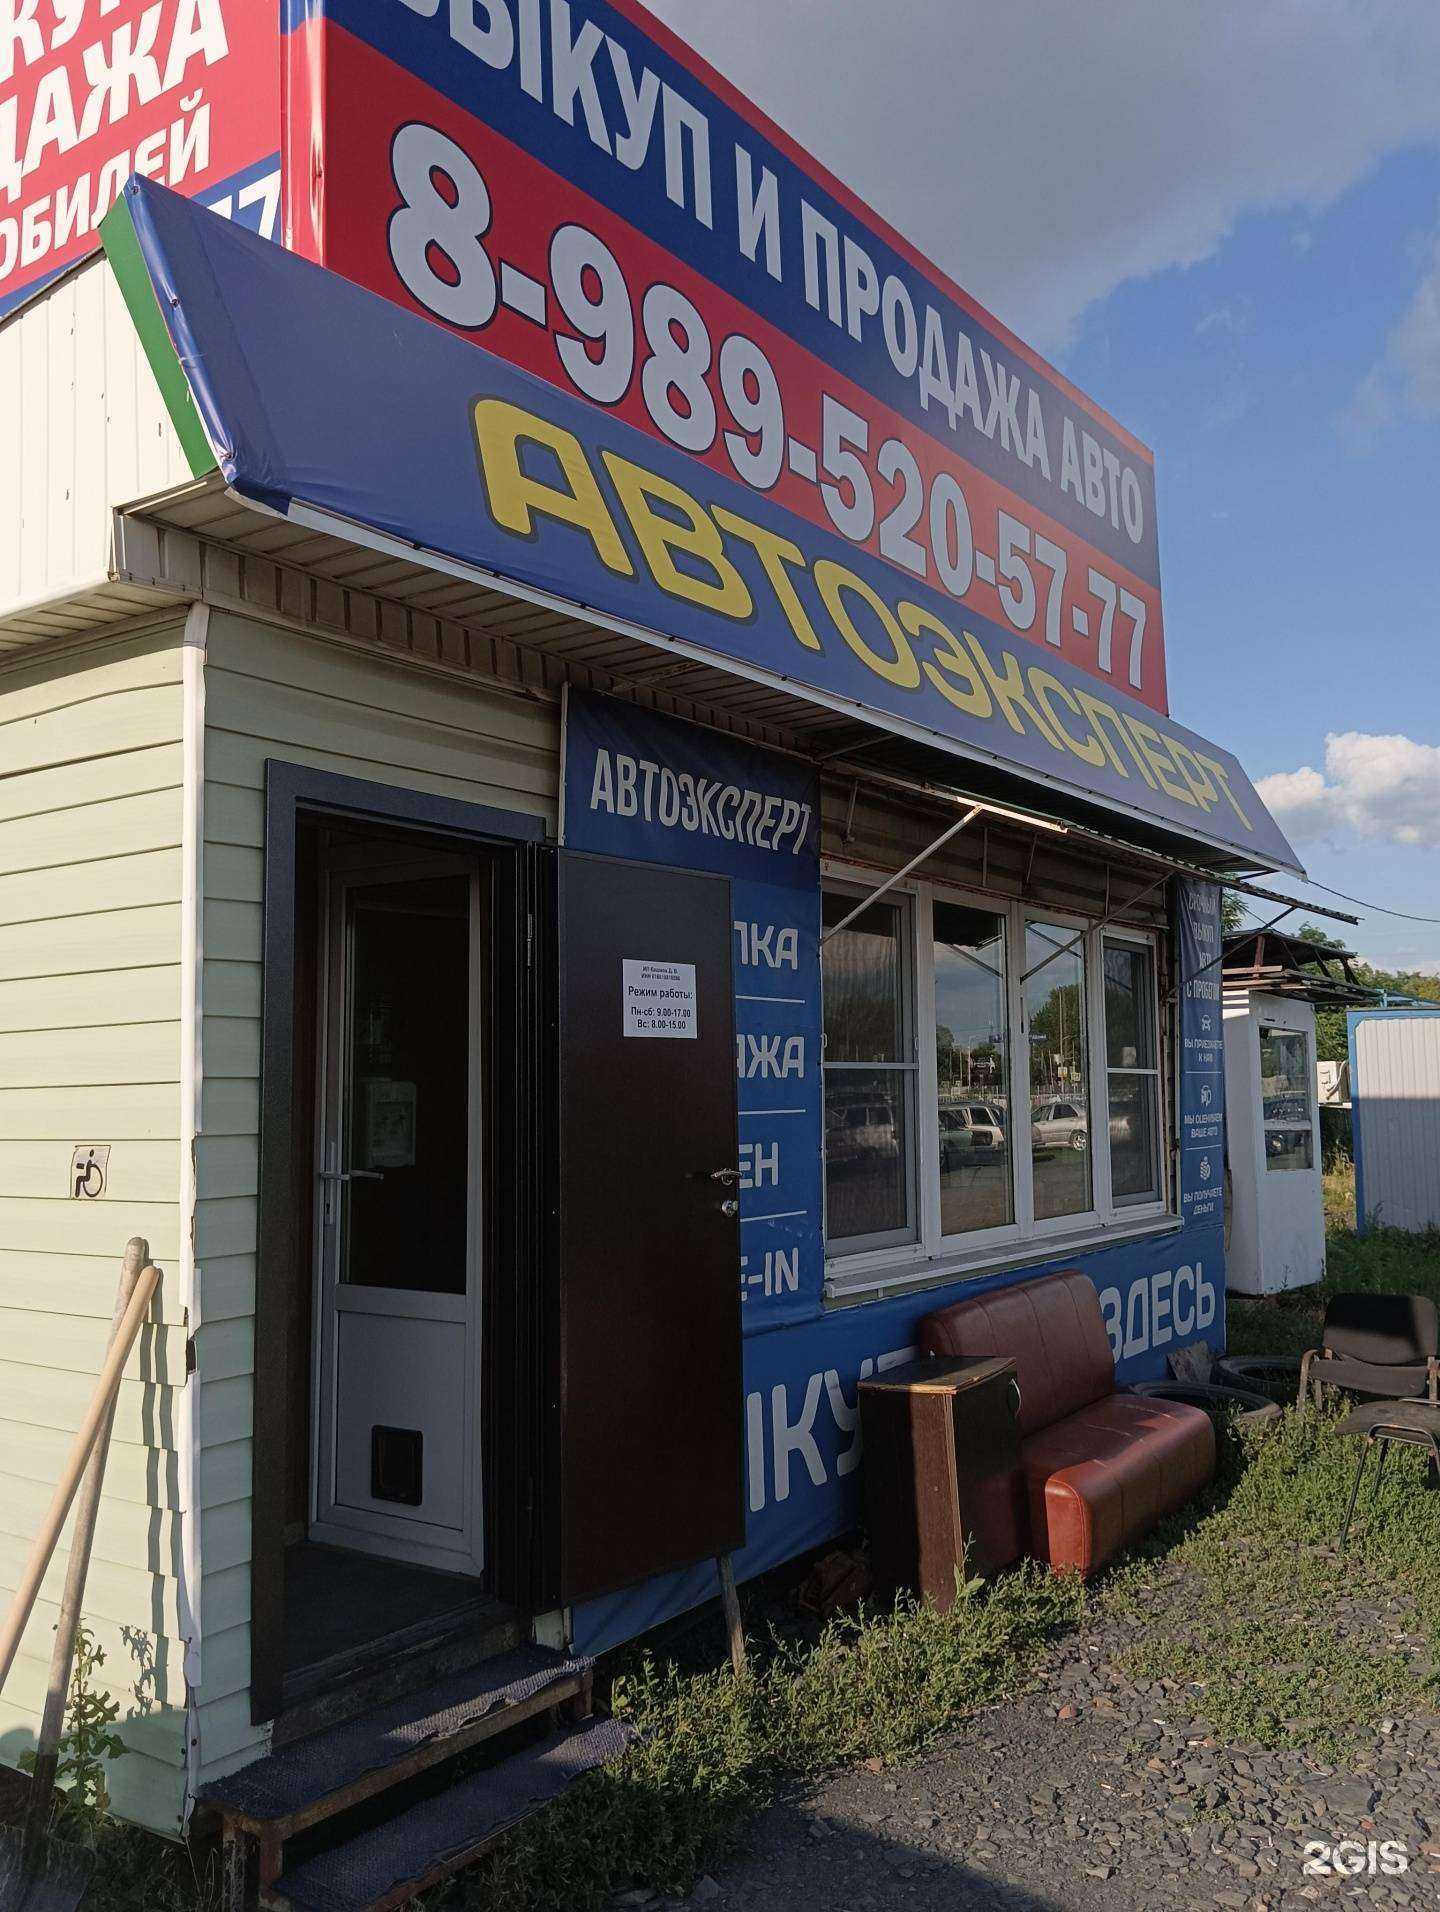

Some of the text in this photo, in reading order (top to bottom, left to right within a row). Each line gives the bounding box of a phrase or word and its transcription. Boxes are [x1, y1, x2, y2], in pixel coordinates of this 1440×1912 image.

[0, 0, 120, 84] КУ
[405, 0, 1144, 545] ЫКУП И ПРОДАЖА АВТО
[386, 120, 1148, 690] 8-989-520-57-77
[473, 398, 1254, 832] АВТОЭКСПЕРТ
[590, 748, 811, 855] АВТОЭКСПЕРТ
[628, 986, 693, 999] Режим работы:
[631, 1006, 691, 1018] Пн-сб: 9.00-17.00
[637, 1018, 686, 1030] Вс: 8.00-15.00
[1100, 1262, 1215, 1365] ЗДЕСЬ
